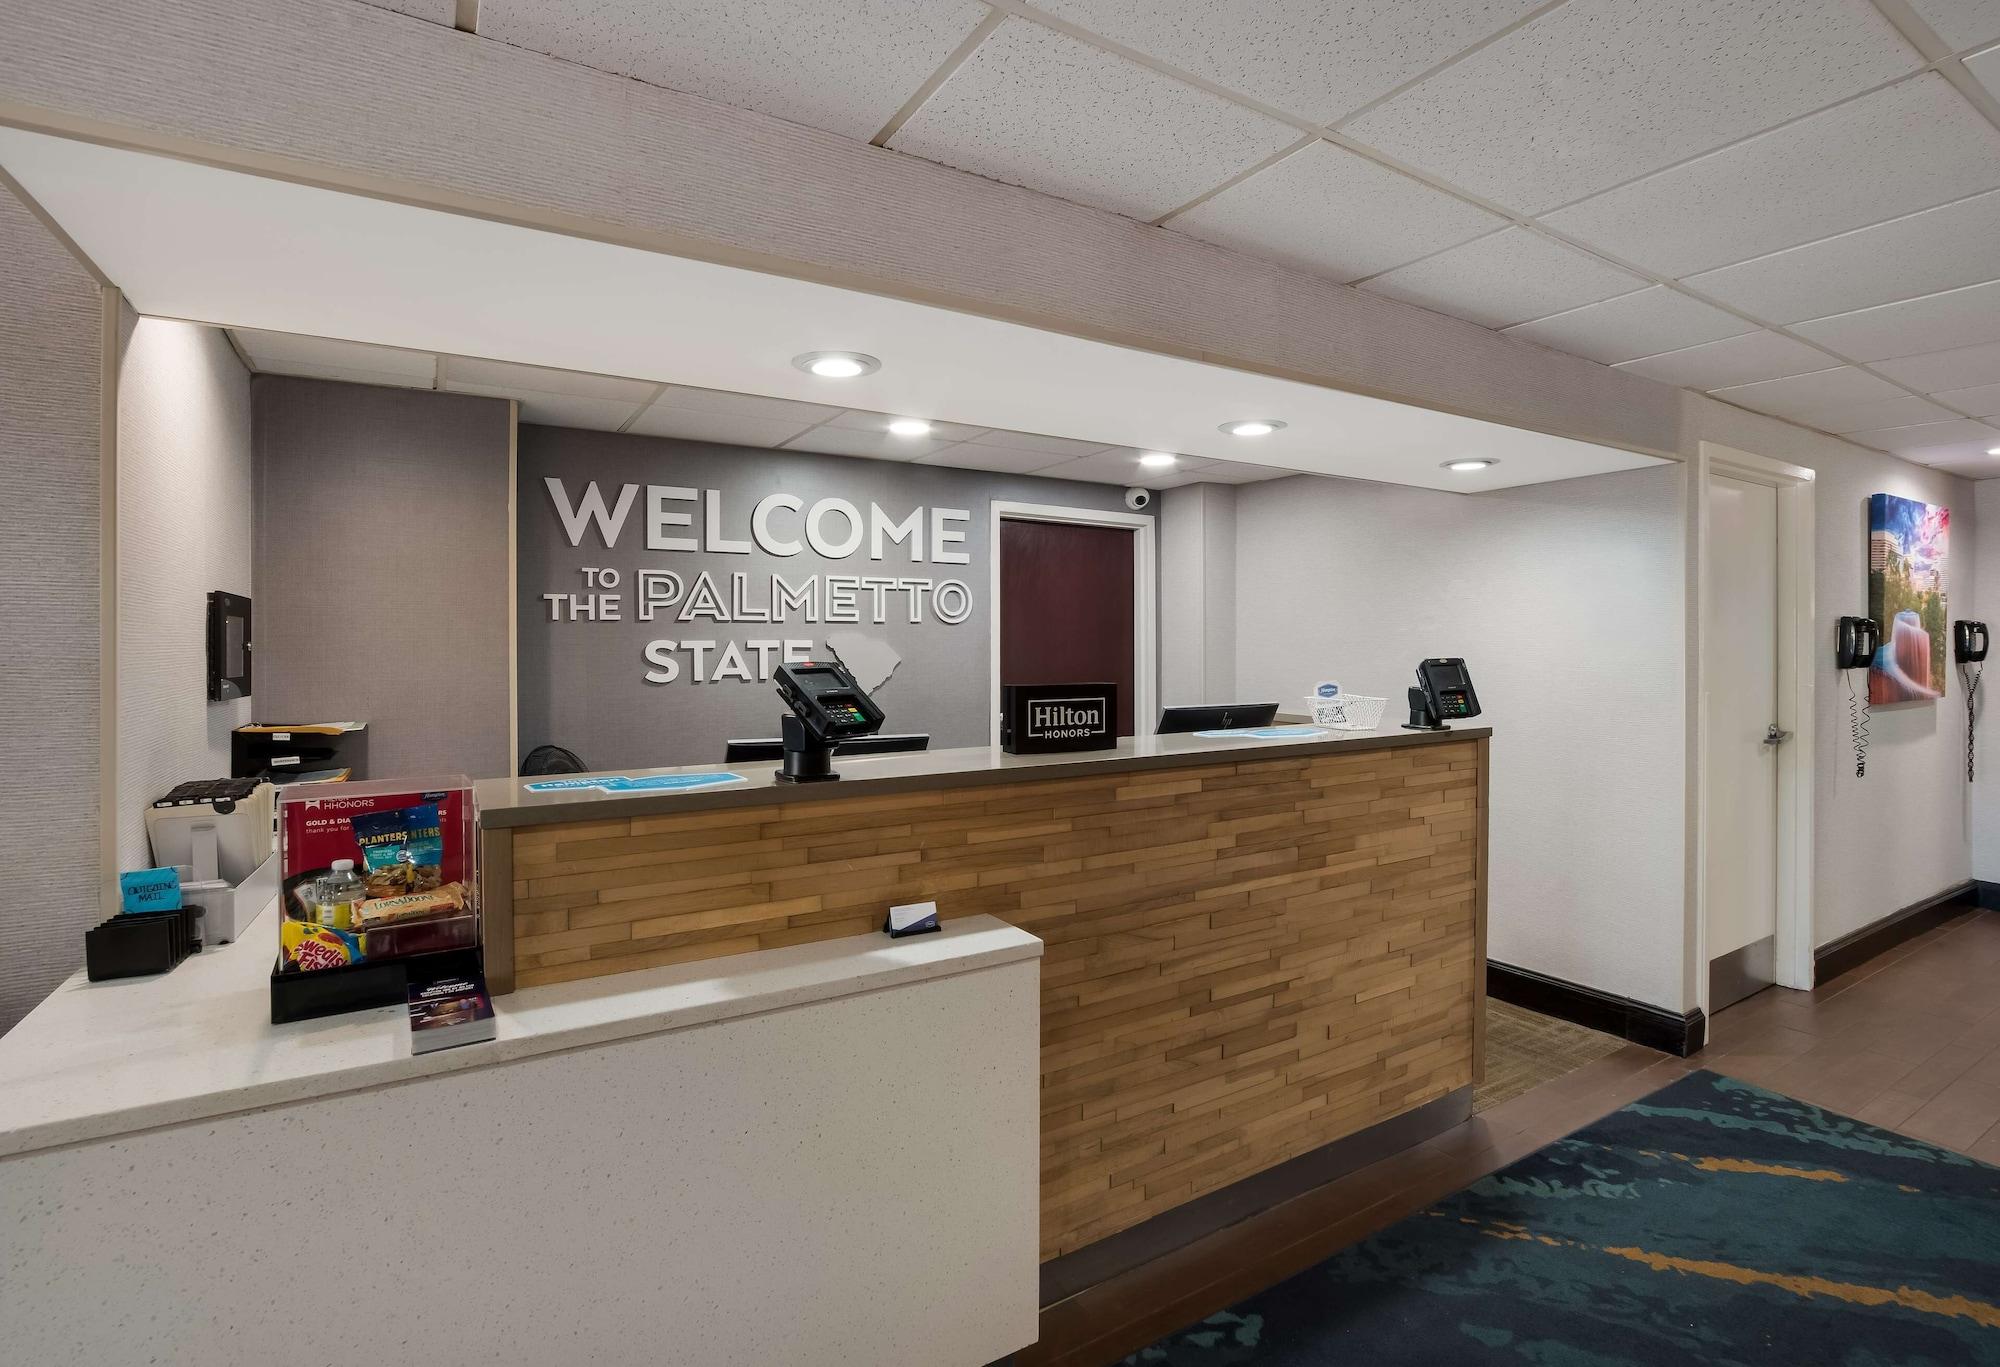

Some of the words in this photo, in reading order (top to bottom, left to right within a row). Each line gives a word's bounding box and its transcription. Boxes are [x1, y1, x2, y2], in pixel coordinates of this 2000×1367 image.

[544, 477, 970, 564] WELCOME
[581, 567, 621, 588] TO
[543, 593, 621, 621] THE
[638, 569, 973, 624] PALMETTO
[1034, 705, 1100, 727] Hilton
[1044, 728, 1091, 739] HONORS
[323, 799, 375, 810] HHONORS
[305, 826, 325, 834] thank
[359, 831, 408, 846] PLANTERS
